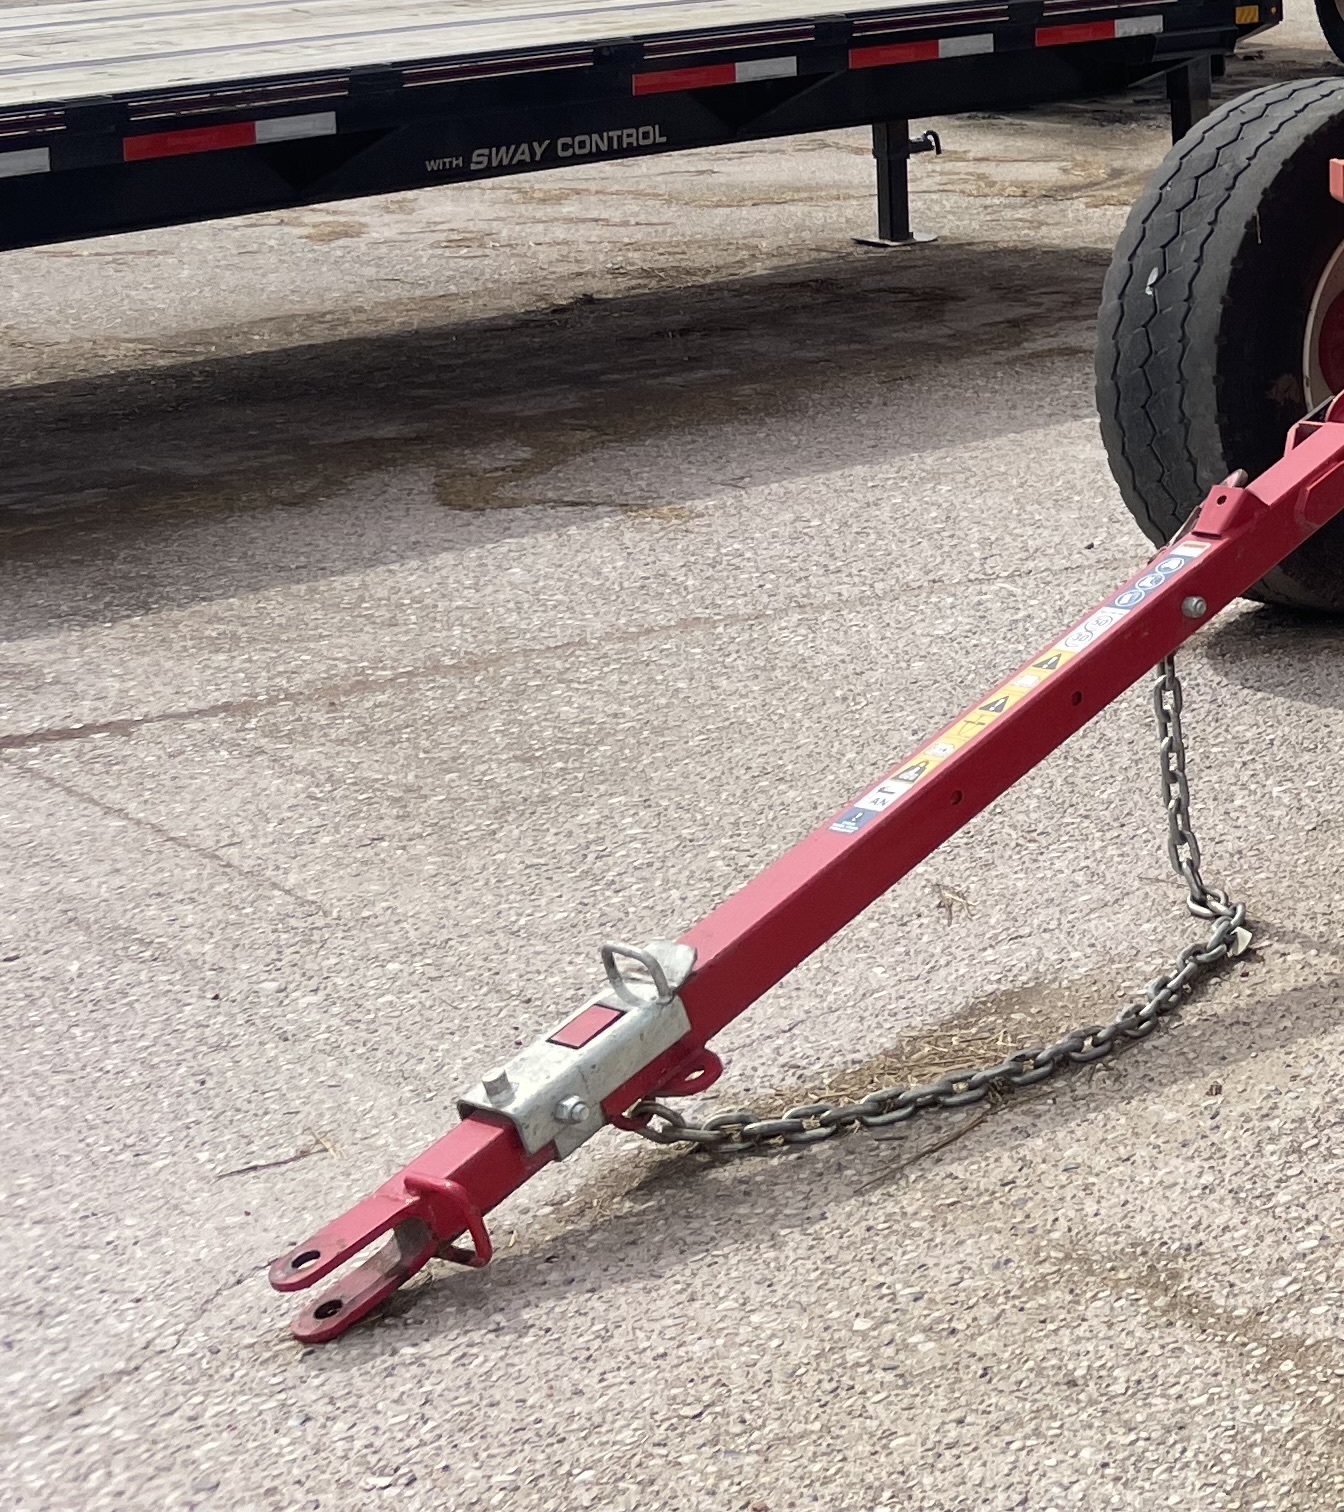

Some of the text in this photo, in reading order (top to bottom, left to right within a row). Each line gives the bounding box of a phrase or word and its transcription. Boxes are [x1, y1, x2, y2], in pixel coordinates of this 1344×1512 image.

[425, 124, 667, 172] WITH SWAY CONTROL
